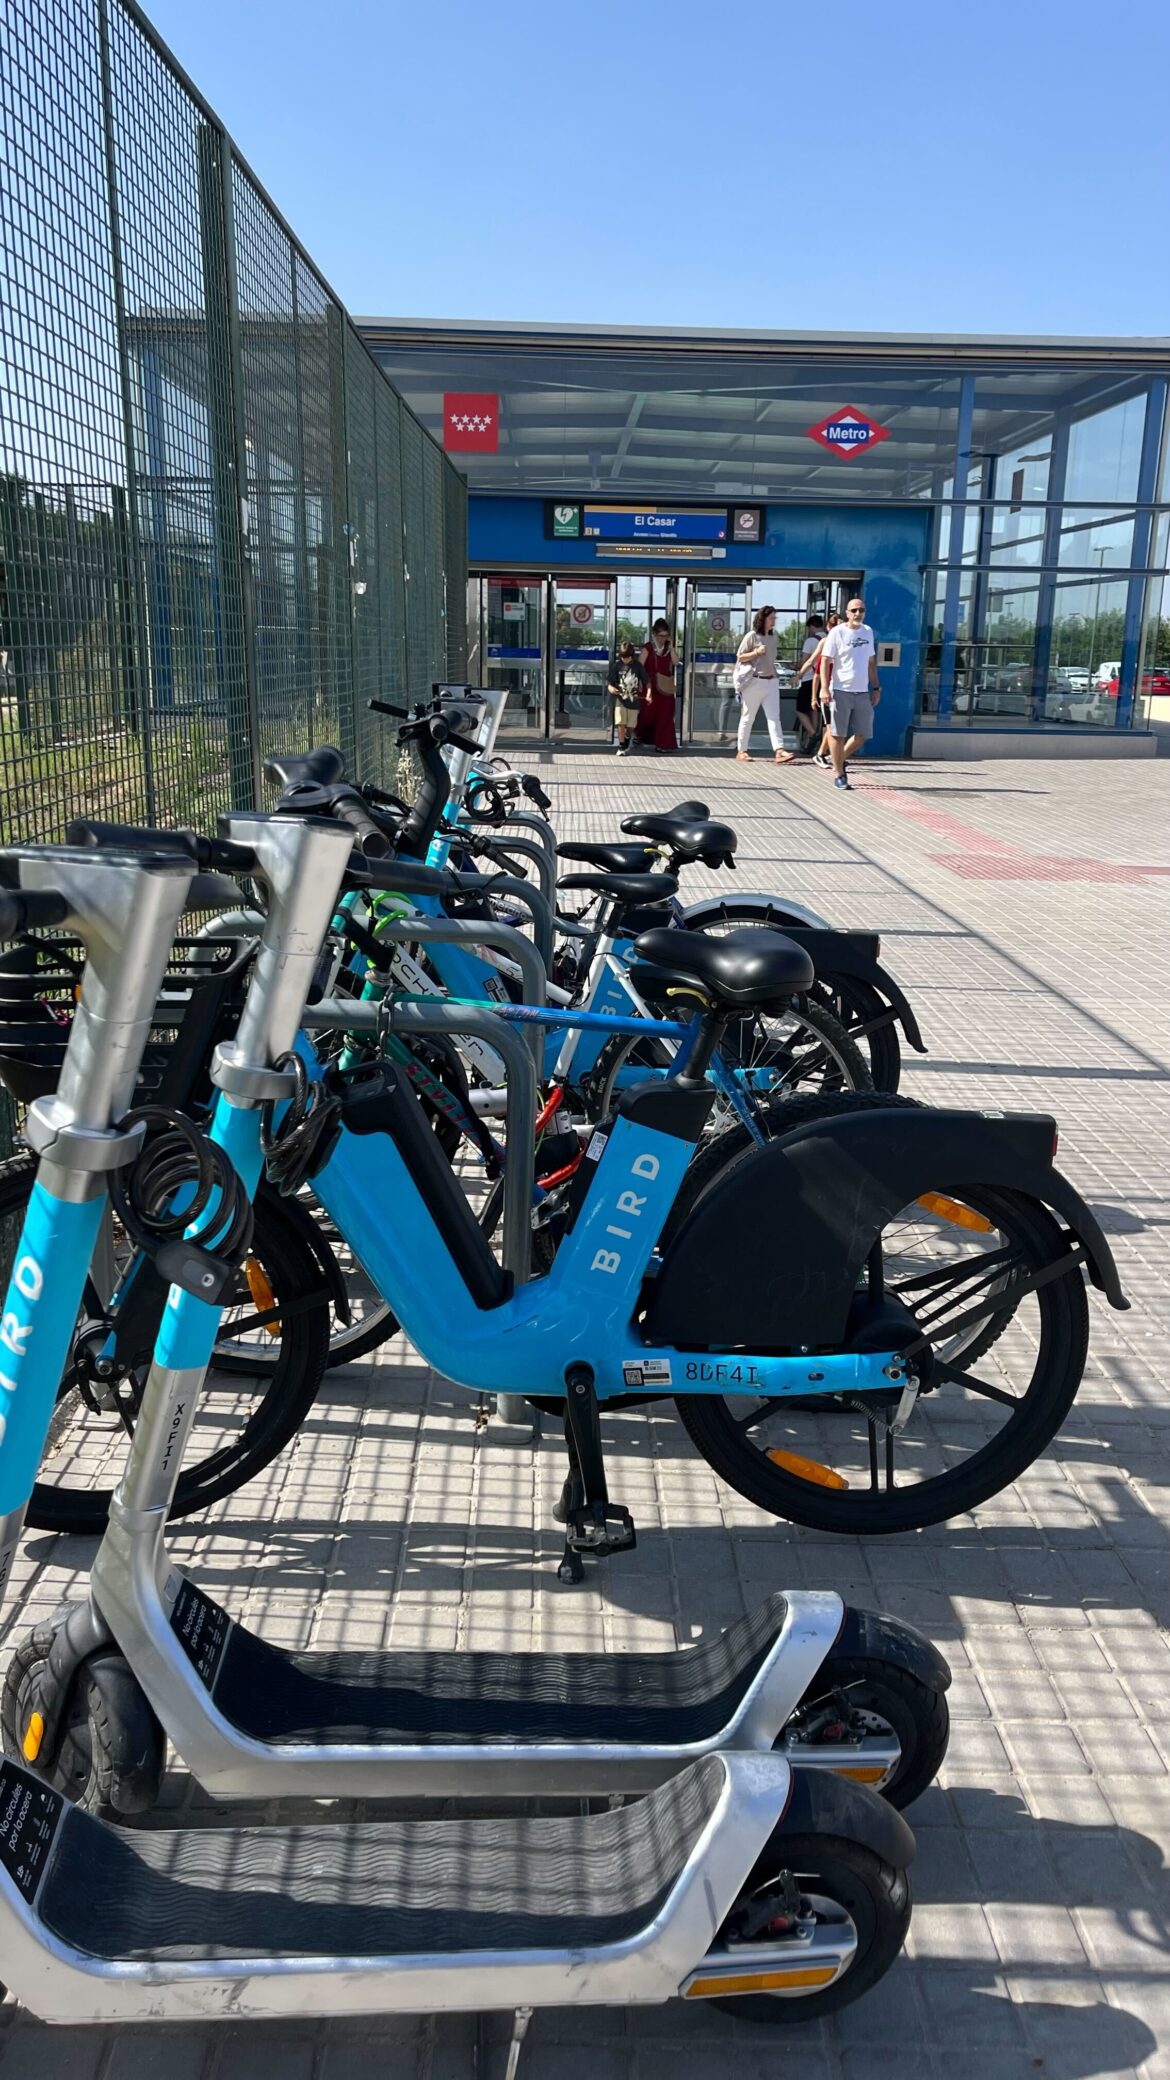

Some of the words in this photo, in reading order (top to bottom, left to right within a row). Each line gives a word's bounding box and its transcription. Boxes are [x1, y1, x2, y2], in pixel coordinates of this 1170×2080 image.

[829, 427, 867, 439] Metro
[635, 516, 644, 526] El
[647, 516, 676, 527] Casar
[590, 1153, 660, 1274] BIRD
[182, 1622, 191, 1636] No
[187, 1596, 199, 1624] circules
[190, 1634, 199, 1650] por
[0, 1819, 9, 1837] No
[6, 1782, 23, 1819] circules
[9, 1829, 19, 1852] por
[14, 1818, 23, 1832] la
[19, 1791, 33, 1820] acera
